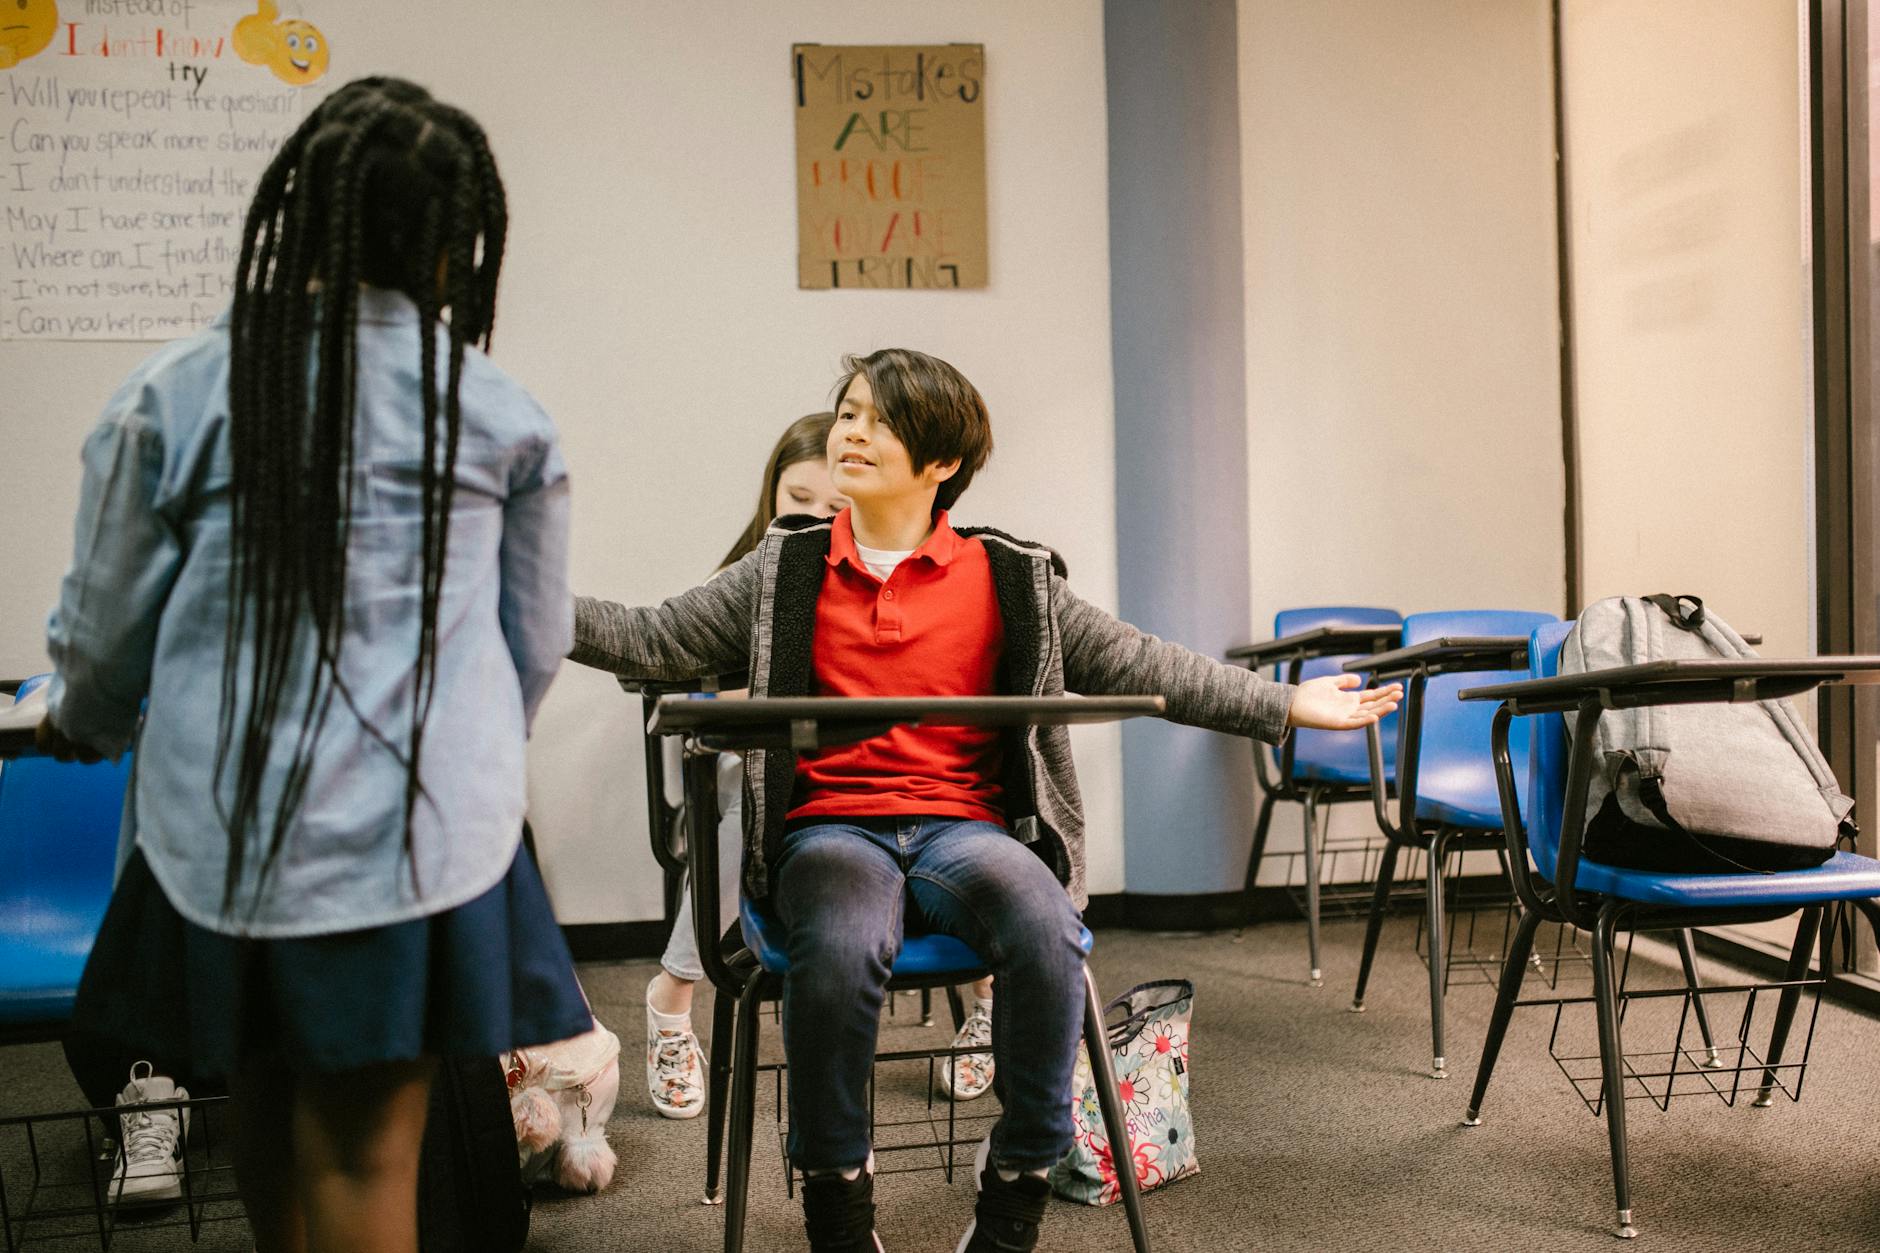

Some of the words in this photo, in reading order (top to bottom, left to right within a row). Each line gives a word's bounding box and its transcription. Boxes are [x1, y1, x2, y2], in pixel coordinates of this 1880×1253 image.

[57, 22, 85, 56] I
[166, 61, 208, 97] try
[795, 52, 980, 107] Mistakes
[9, 74, 60, 109] Will
[66, 88, 97, 122] you
[100, 88, 173, 118] repeat
[184, 88, 216, 112] the
[10, 118, 55, 154] Can
[60, 132, 90, 163] you
[97, 127, 160, 158] speak
[163, 132, 209, 152] more
[832, 108, 928, 152] ARE
[10, 162, 34, 192] I
[109, 165, 214, 197] understand
[219, 166, 250, 197] the
[5, 206, 58, 243] May
[66, 206, 90, 232] I
[100, 207, 147, 230] have
[12, 241, 84, 269] Where
[90, 250, 124, 268] can
[129, 242, 154, 269] I
[159, 238, 210, 275] find
[213, 237, 239, 264] the
[817, 256, 961, 289] TRYING
[11, 279, 59, 301] I'm
[67, 279, 101, 297] not
[156, 278, 190, 298] but
[194, 273, 216, 298] I
[17, 306, 62, 335] Can
[67, 316, 101, 337] you
[105, 312, 154, 338] help
[1127, 1106, 1166, 1137] ayna
